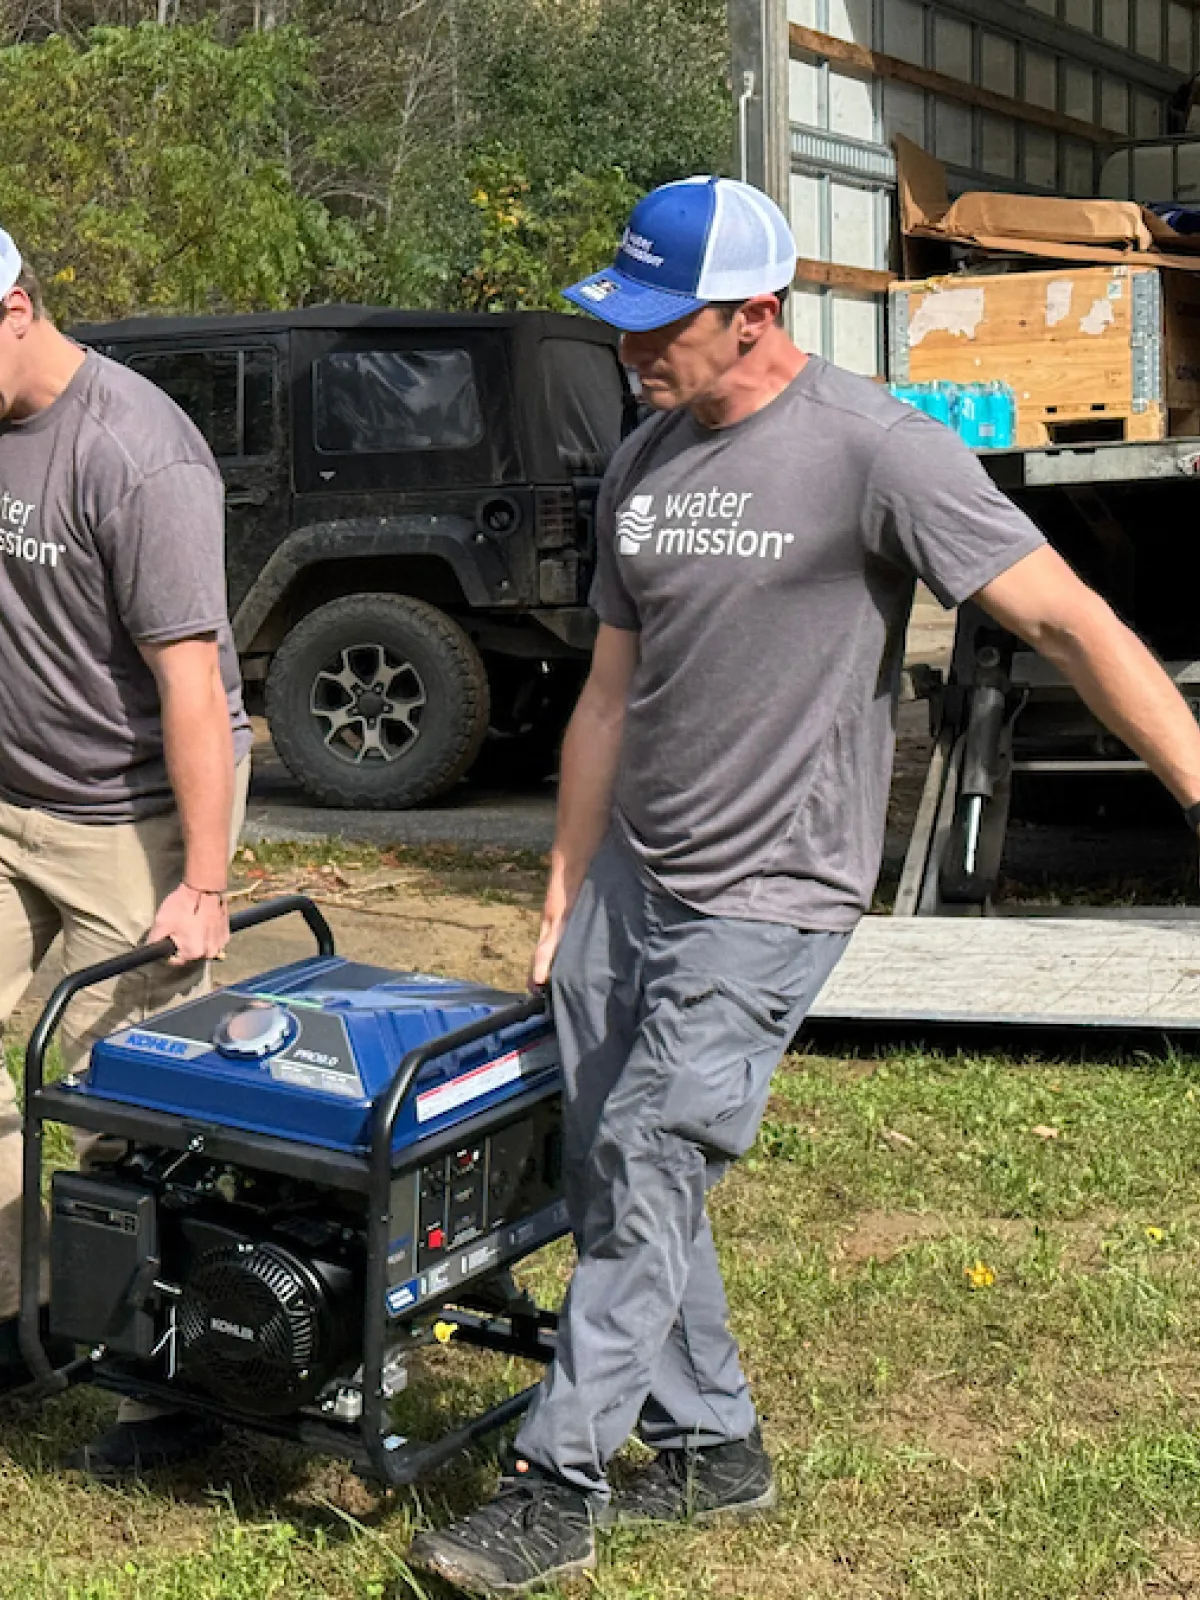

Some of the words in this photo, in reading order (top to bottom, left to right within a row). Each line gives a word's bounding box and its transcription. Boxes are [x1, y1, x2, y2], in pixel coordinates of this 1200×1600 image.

[665, 486, 753, 519] water
[656, 519, 783, 560] mission
[210, 1317, 255, 1342] KOHLER
